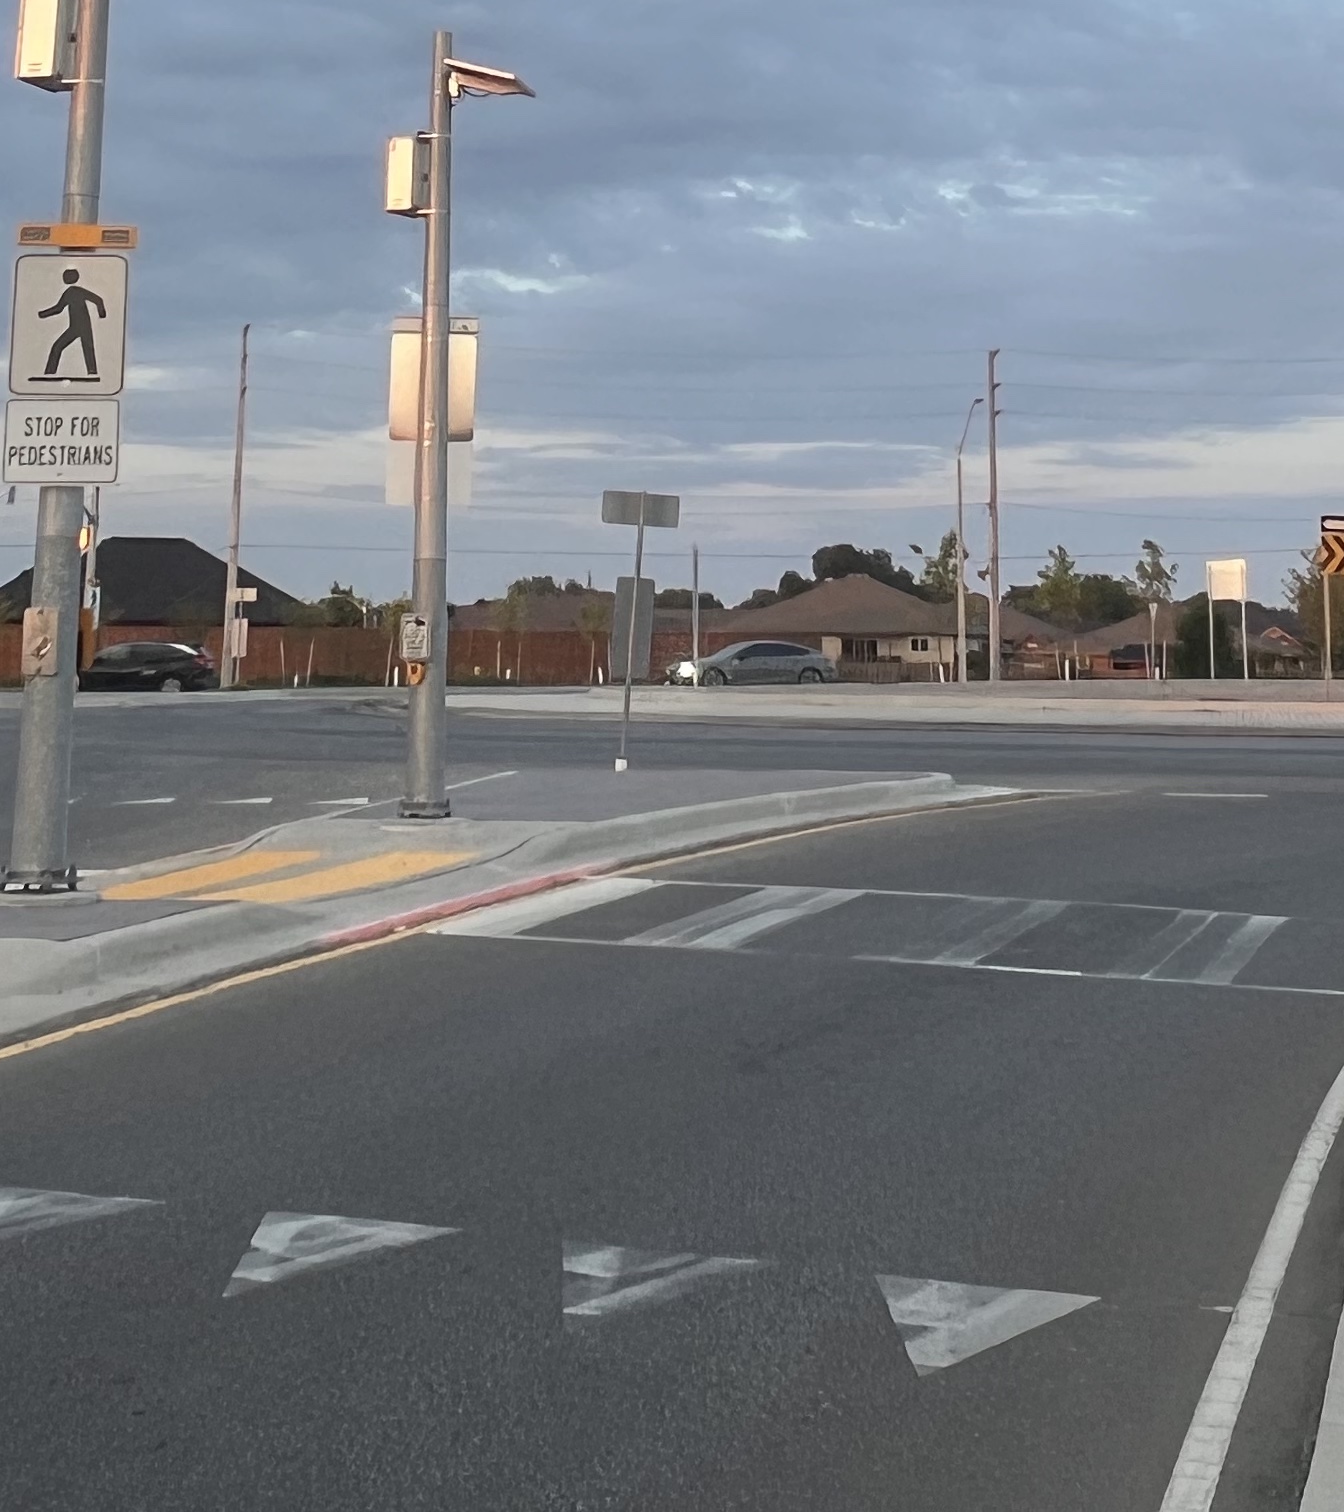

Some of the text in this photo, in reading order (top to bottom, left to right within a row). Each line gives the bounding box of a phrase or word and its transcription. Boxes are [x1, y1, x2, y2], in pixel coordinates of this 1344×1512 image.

[24, 416, 100, 437] STOP FOR
[8, 445, 113, 467] PEDESTRIANS
